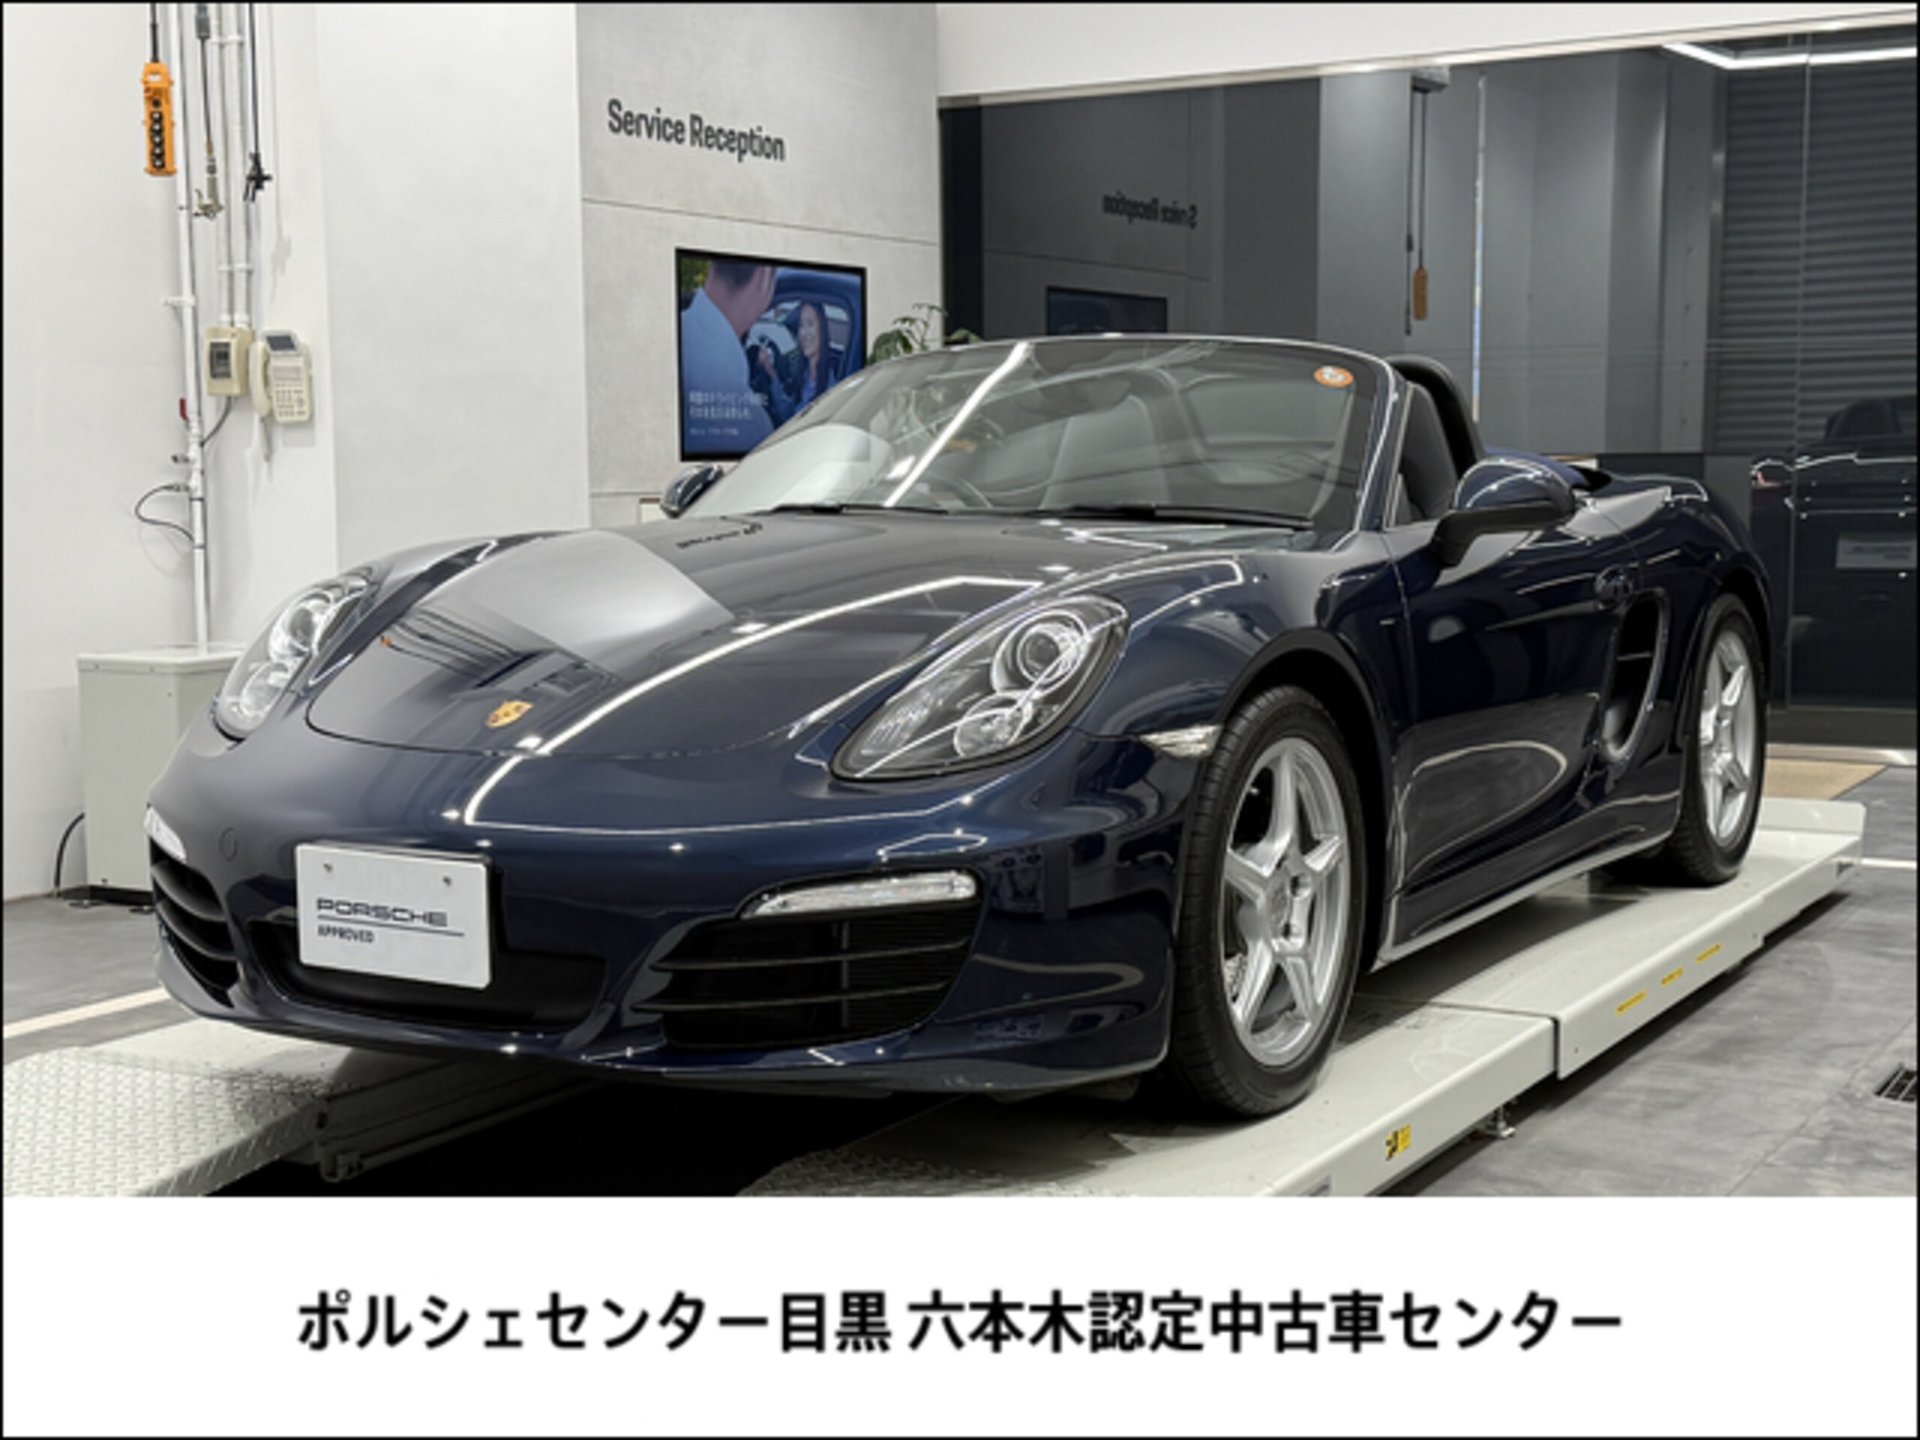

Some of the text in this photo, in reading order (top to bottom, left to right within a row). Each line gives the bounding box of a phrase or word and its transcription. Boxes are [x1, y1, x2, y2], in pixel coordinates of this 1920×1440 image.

[607, 98, 786, 163] Service Reception
[316, 898, 449, 927] PORSCHE
[317, 924, 375, 944] APPROVED
